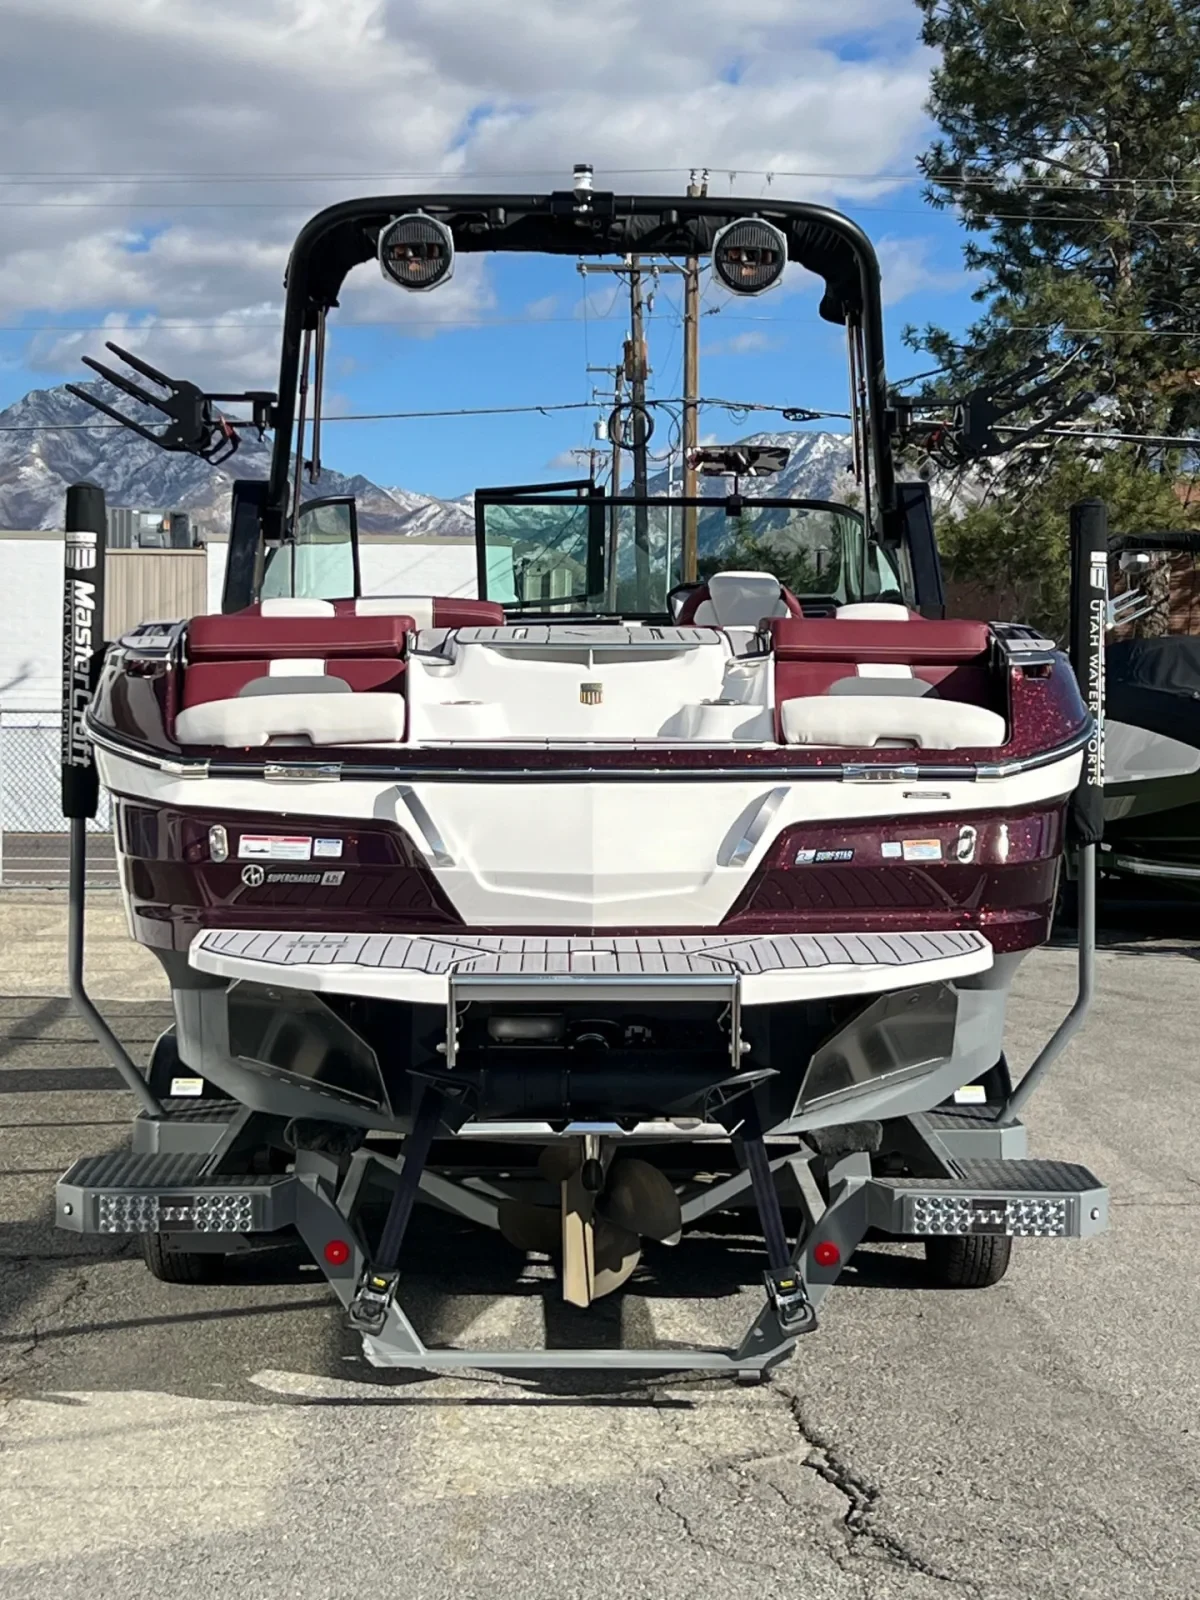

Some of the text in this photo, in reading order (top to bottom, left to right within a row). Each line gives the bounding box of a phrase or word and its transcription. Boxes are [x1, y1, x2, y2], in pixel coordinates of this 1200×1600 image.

[1089, 600, 1099, 646] UTAH
[1088, 654, 1099, 711] WATER
[266, 873, 321, 883] SUPERCHARGED
